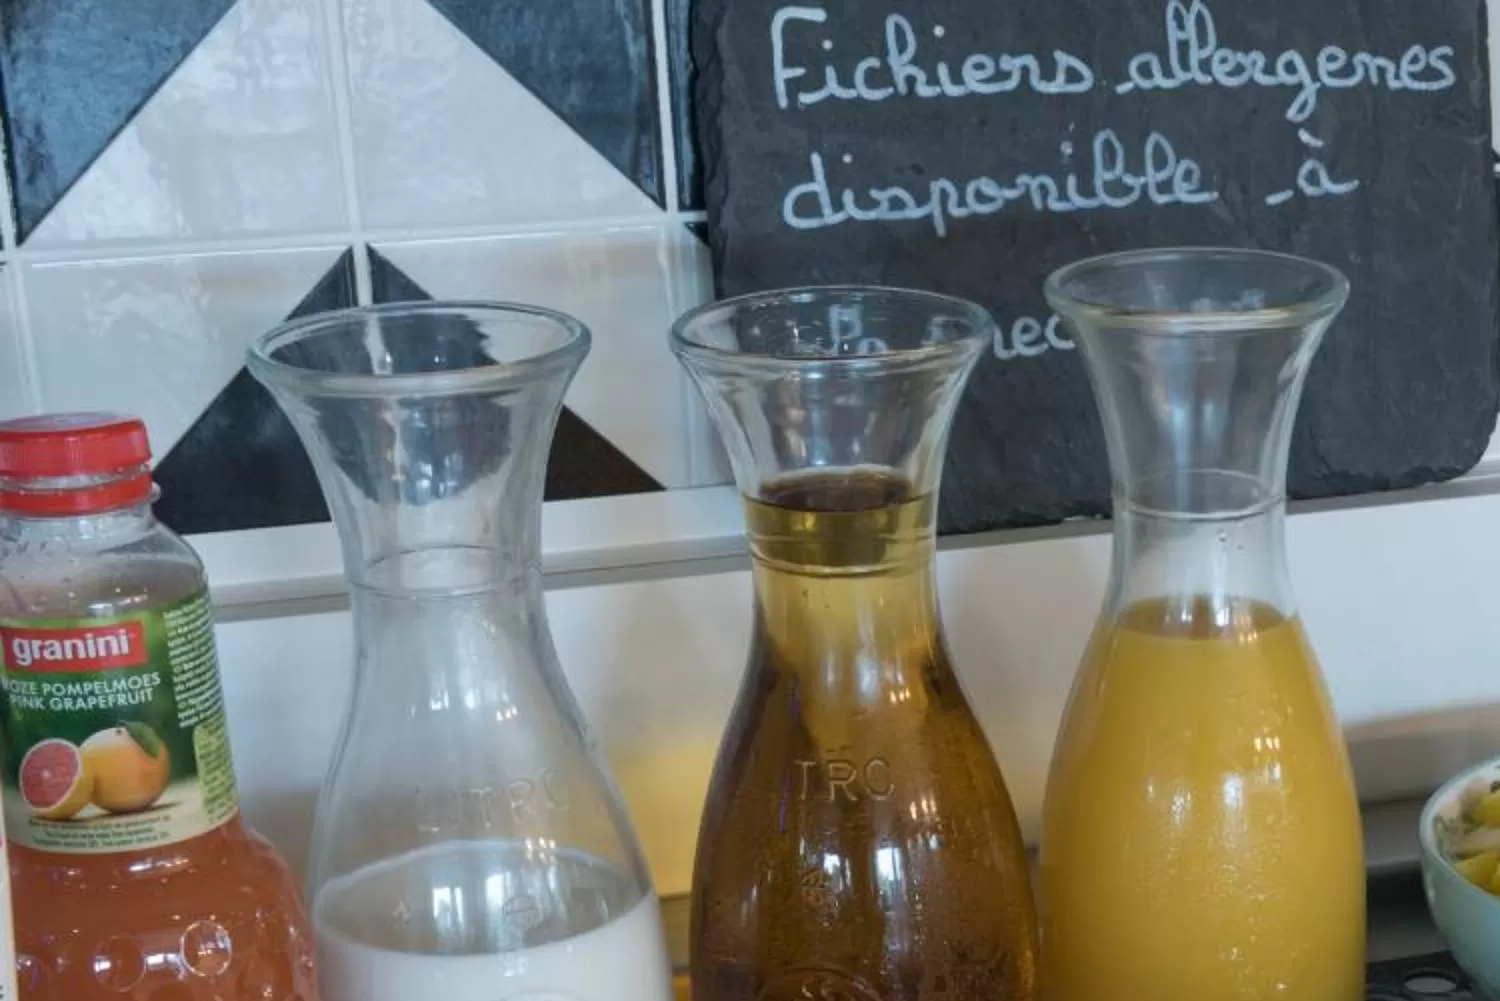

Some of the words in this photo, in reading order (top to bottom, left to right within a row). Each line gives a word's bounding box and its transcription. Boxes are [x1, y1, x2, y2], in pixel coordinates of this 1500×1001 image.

[771, 6, 1094, 108] Fichiers
[783, 129, 1219, 237] disponible
[11, 628, 130, 665] granini
[10, 694, 46, 709] PINK
[49, 687, 153, 711] GRAPEFRUIT
[42, 671, 160, 696] POMPELMOES
